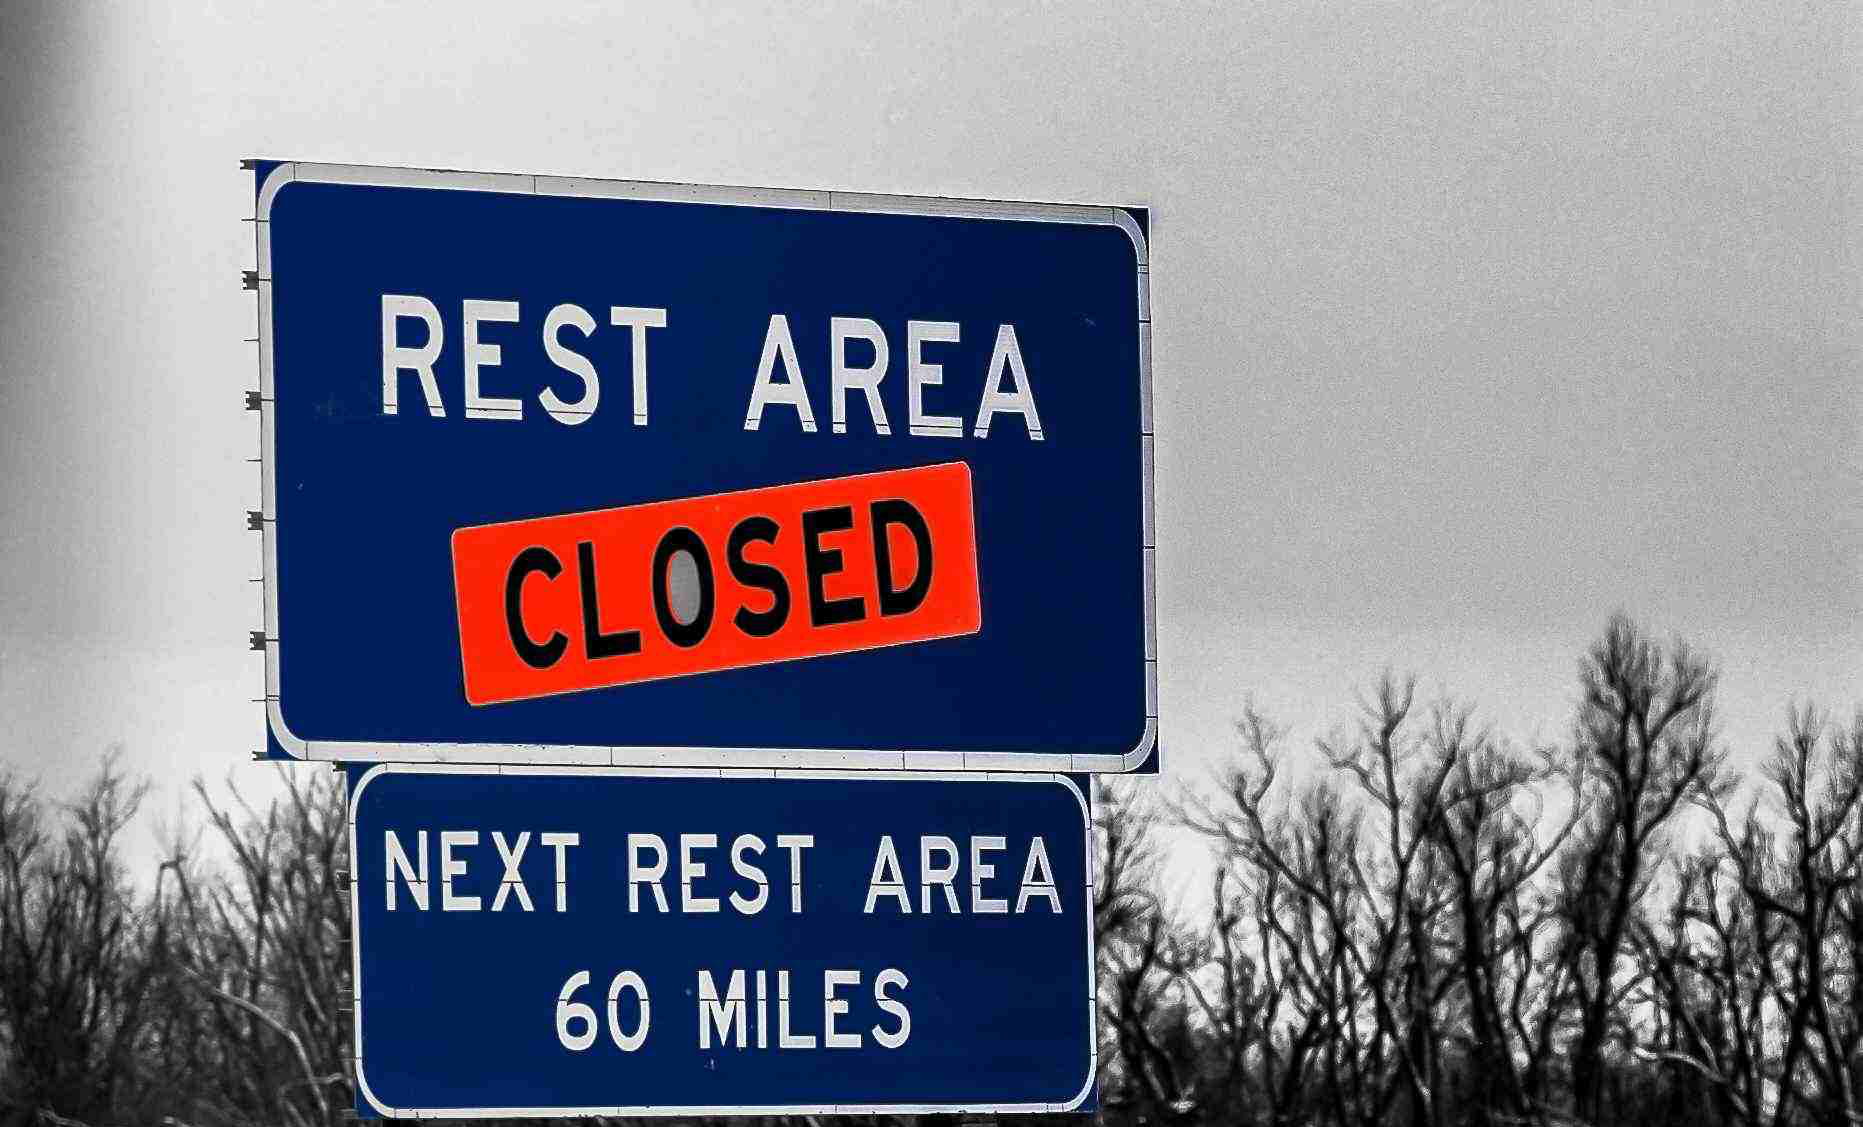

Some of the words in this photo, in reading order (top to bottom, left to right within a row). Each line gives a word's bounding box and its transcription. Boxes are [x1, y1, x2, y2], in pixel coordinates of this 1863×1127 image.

[380, 294, 668, 426] REST
[744, 314, 1045, 441] AREA
[504, 498, 934, 669] CLOSED
[384, 830, 580, 912] NEXT
[627, 833, 814, 914] REST
[863, 835, 1063, 914] AREA
[555, 970, 650, 1052] 60
[698, 968, 912, 1050] MILES
